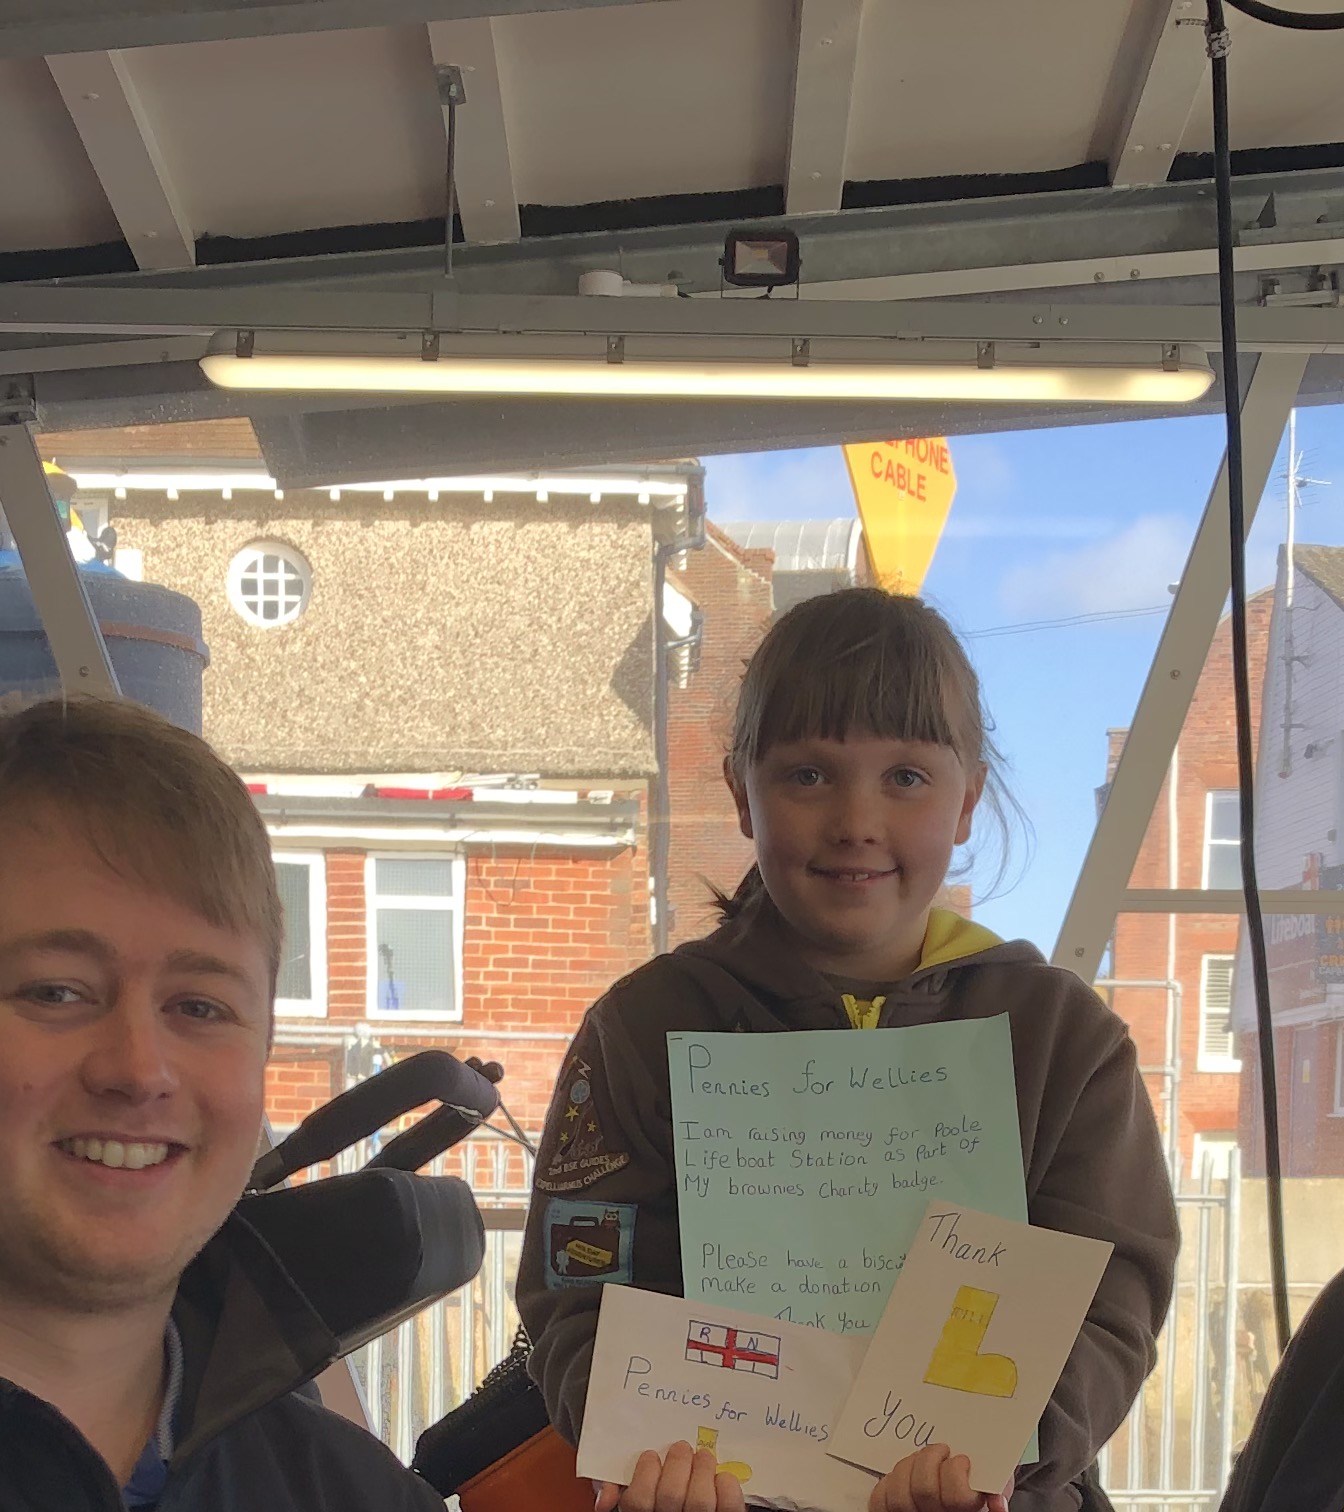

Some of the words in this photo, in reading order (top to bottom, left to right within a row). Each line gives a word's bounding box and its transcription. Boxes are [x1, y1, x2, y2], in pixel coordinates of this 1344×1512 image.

[871, 451, 927, 502] CABLE
[688, 1043, 772, 1098] Pennies
[792, 1059, 834, 1095] for
[849, 1065, 948, 1091] Wellies
[748, 1126, 806, 1146] raising
[820, 1129, 873, 1148] money
[884, 1127, 920, 1146] for
[935, 1114, 982, 1138] Poole
[580, 1155, 610, 1169] GUIDES
[791, 1149, 868, 1169] Station
[884, 1148, 905, 1162] as
[684, 1174, 710, 1198] My
[728, 1177, 805, 1197] brownies
[928, 1212, 1007, 1267] Thank
[702, 1242, 769, 1270] Please
[787, 1249, 824, 1269] have
[838, 1257, 849, 1269] a
[771, 1282, 787, 1293] a
[798, 1274, 881, 1295] donation
[623, 1356, 711, 1409] Pennies
[715, 1402, 748, 1422] for
[764, 1403, 830, 1442] Wellies
